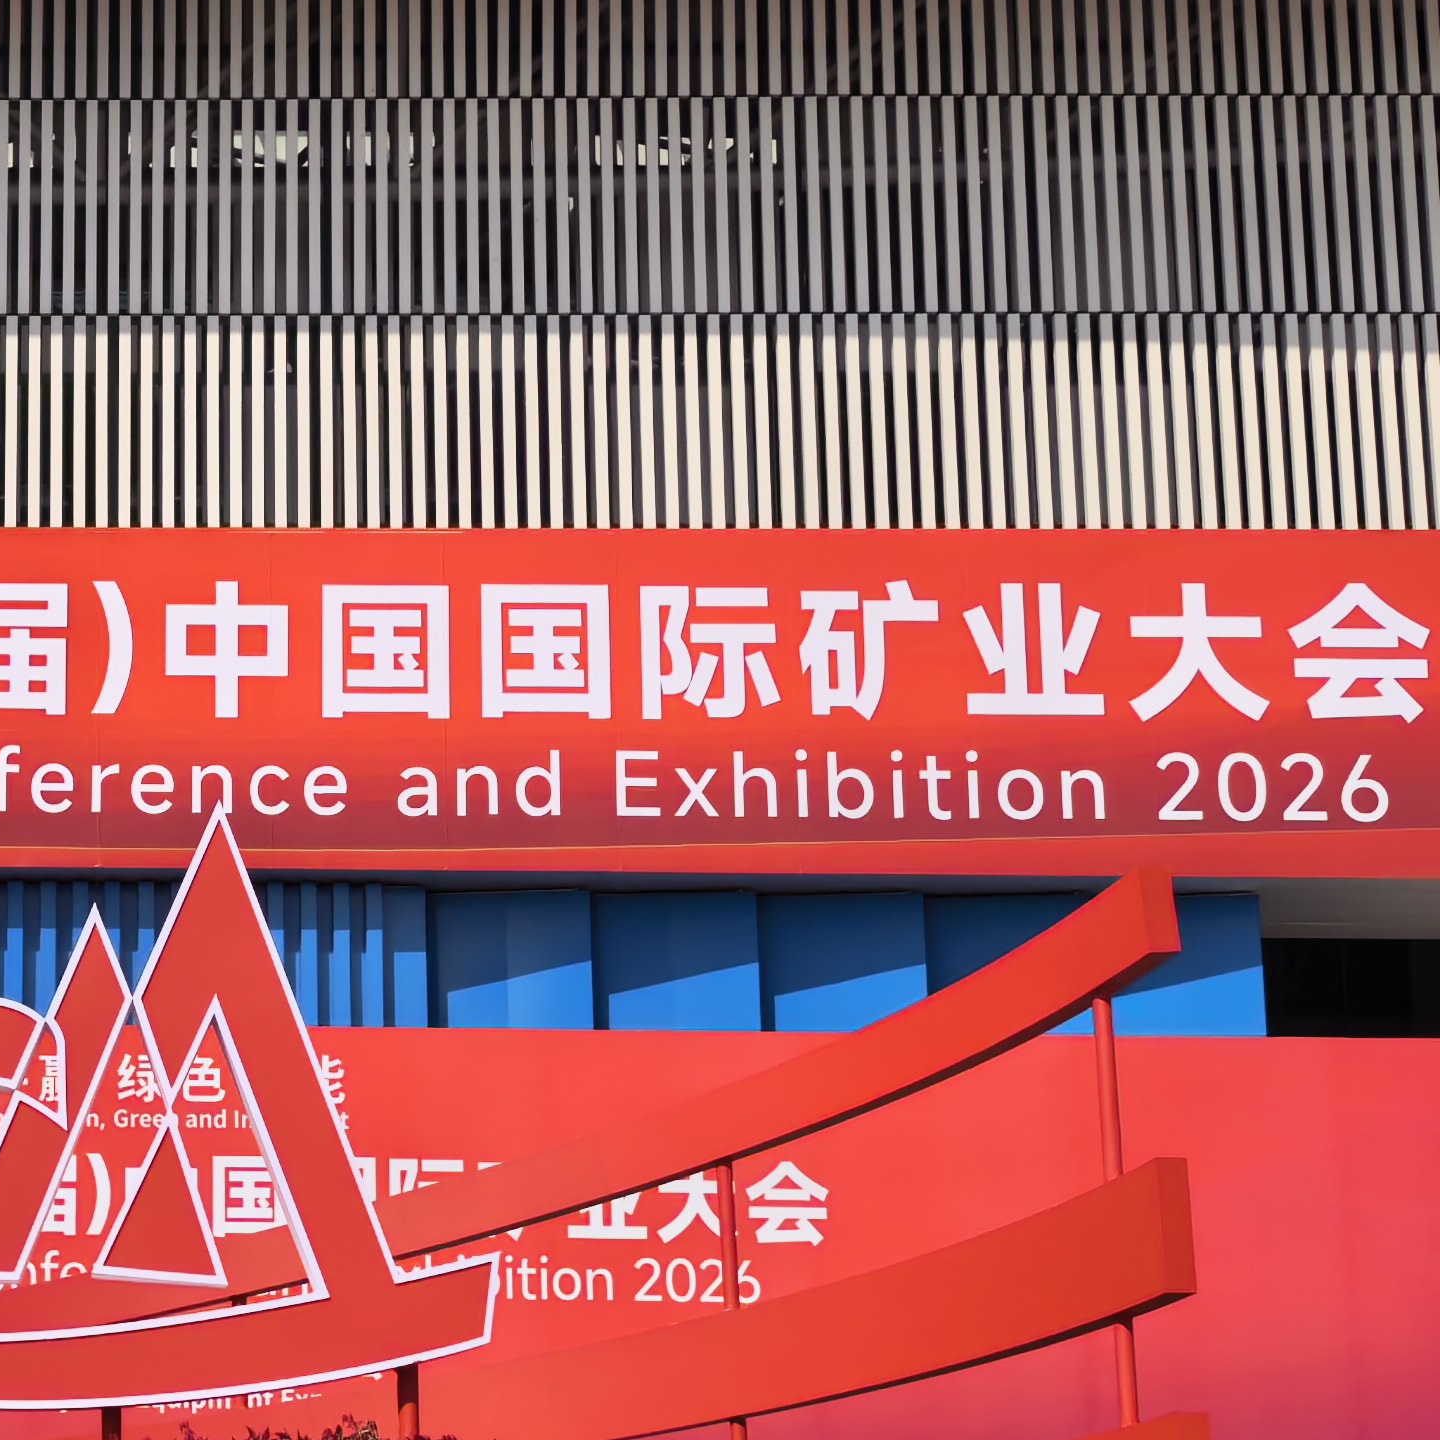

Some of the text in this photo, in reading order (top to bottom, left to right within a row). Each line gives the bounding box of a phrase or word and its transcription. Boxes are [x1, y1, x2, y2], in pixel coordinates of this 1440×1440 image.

[398, 750, 560, 816] and
[616, 749, 1105, 820] Exhibition
[1157, 752, 1388, 822] 2026
[186, 1109, 226, 1128] and
[633, 1256, 761, 1304] 2026
